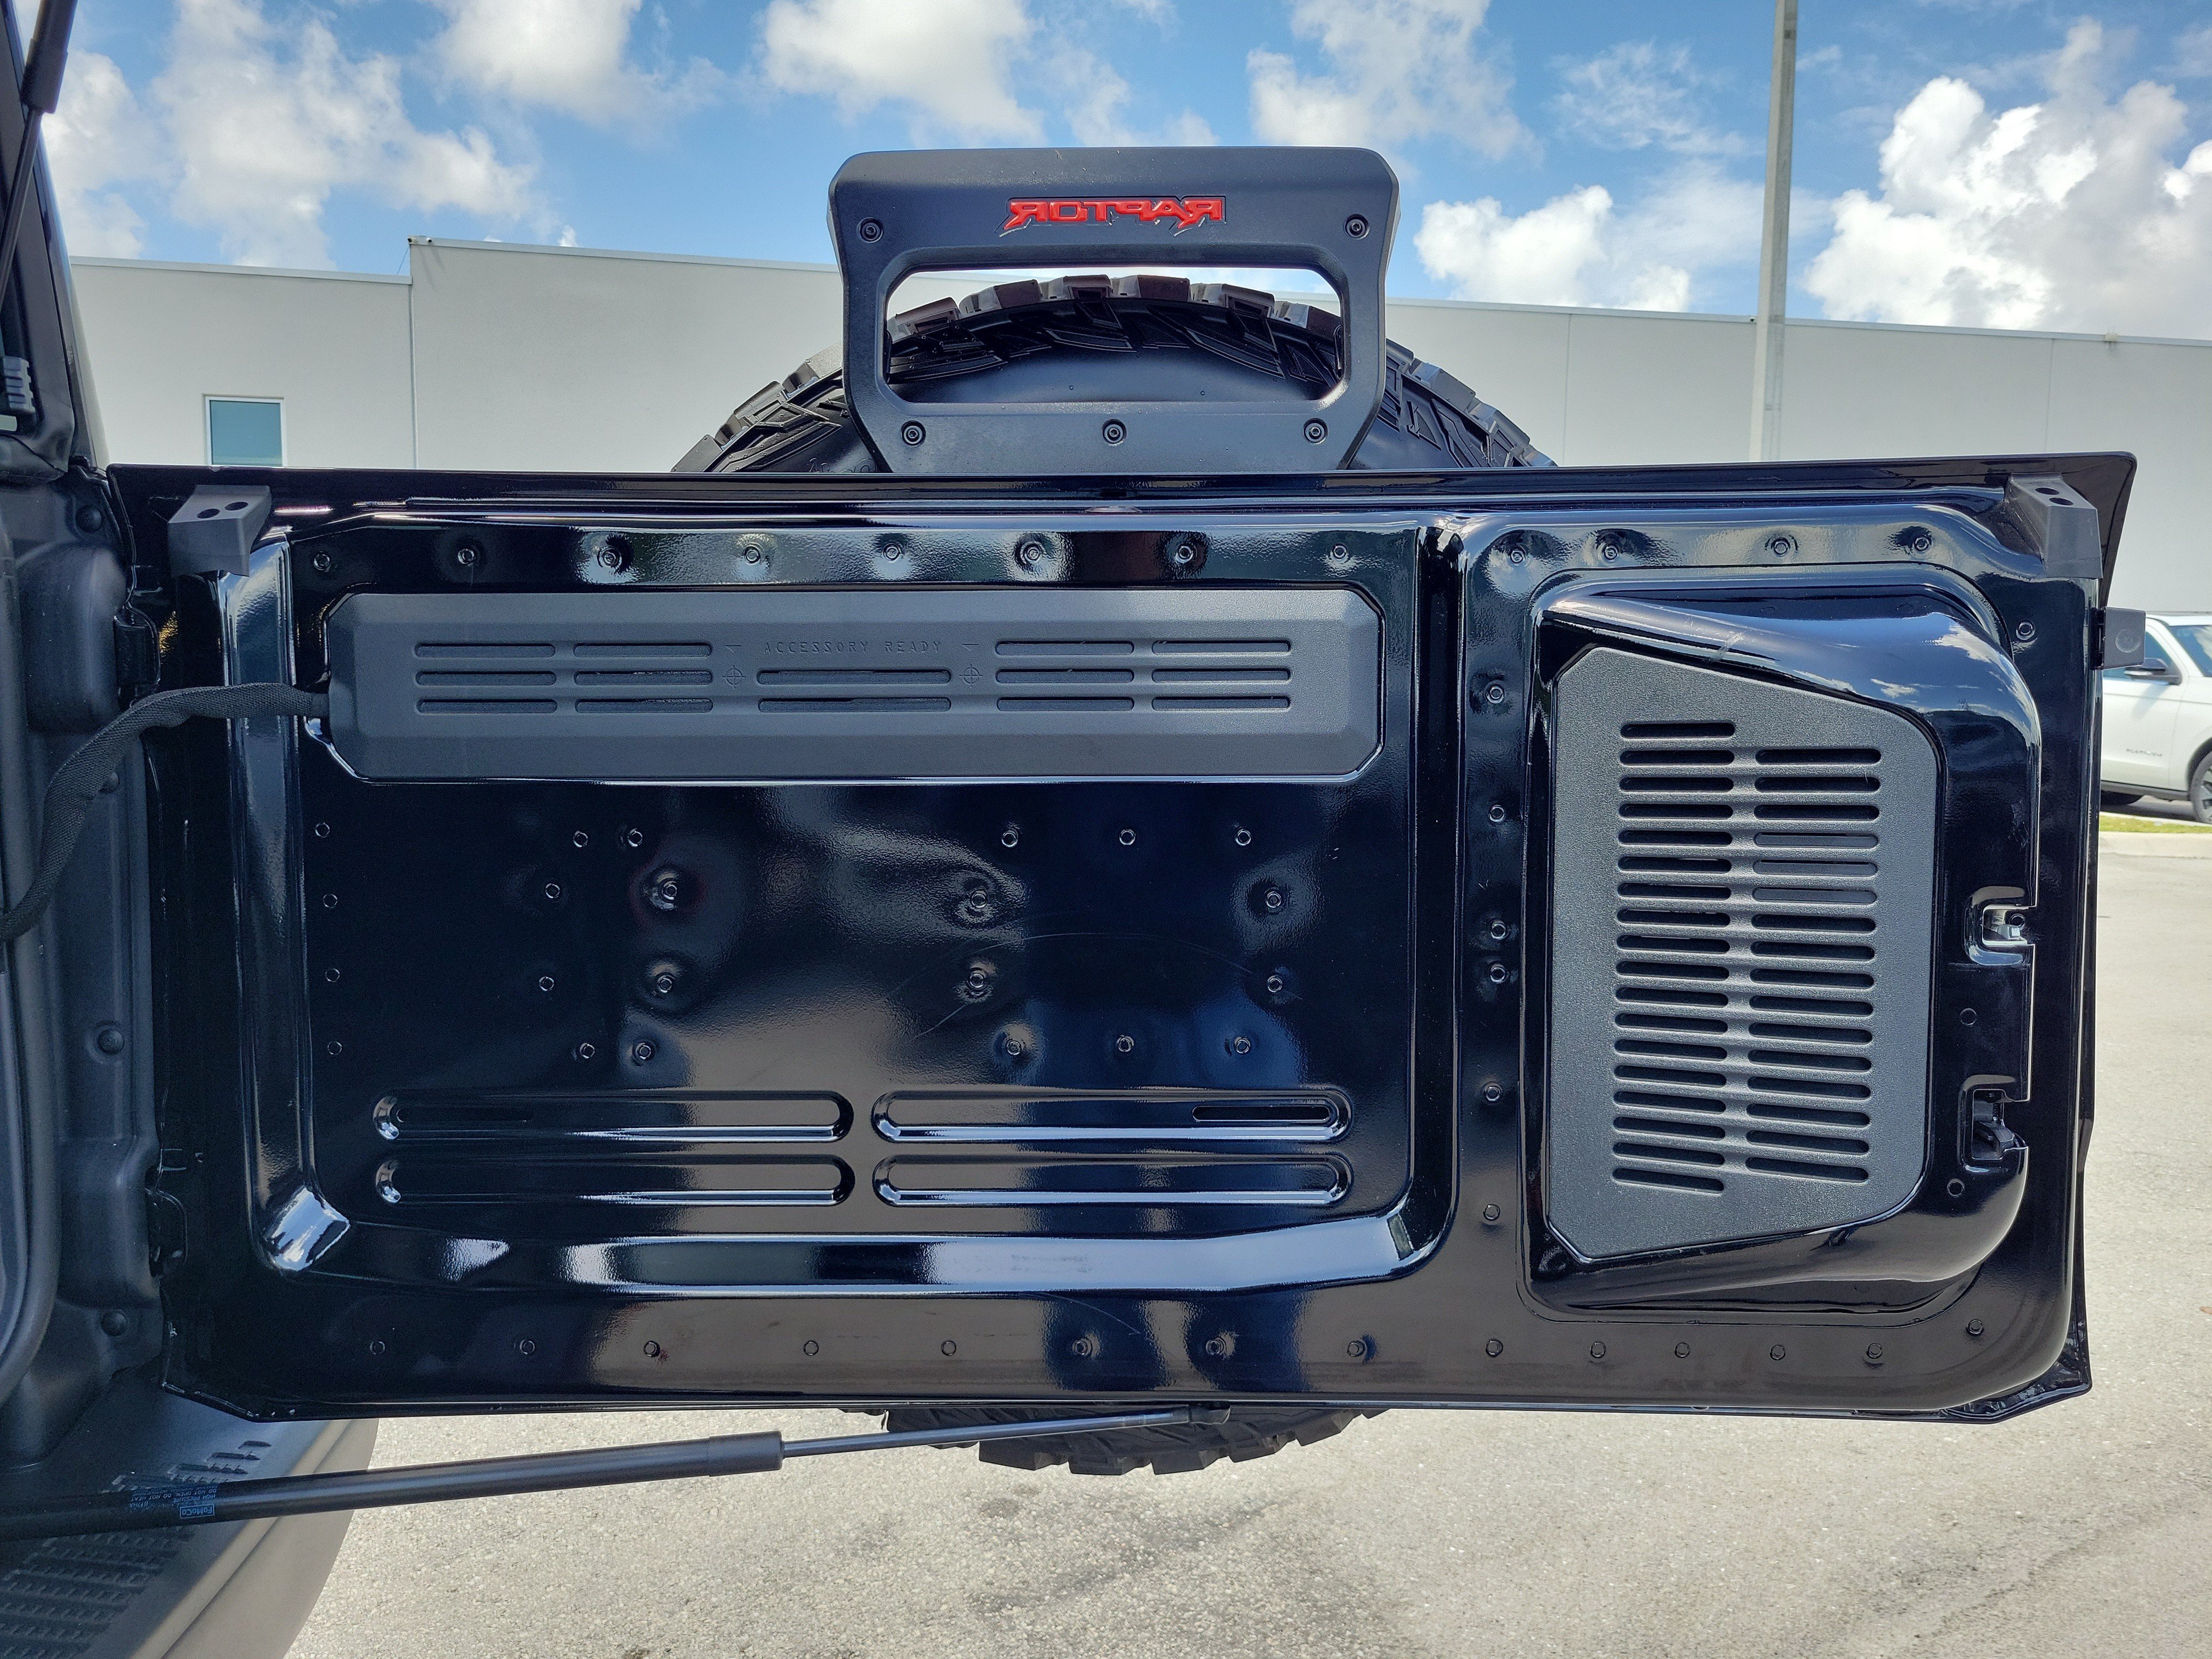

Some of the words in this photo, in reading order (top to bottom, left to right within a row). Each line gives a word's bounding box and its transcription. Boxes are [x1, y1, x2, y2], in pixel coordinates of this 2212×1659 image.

[764, 641, 868, 653] ACCESSORY
[885, 641, 943, 653] READY
[181, 1506, 212, 1516] FoMoCo
